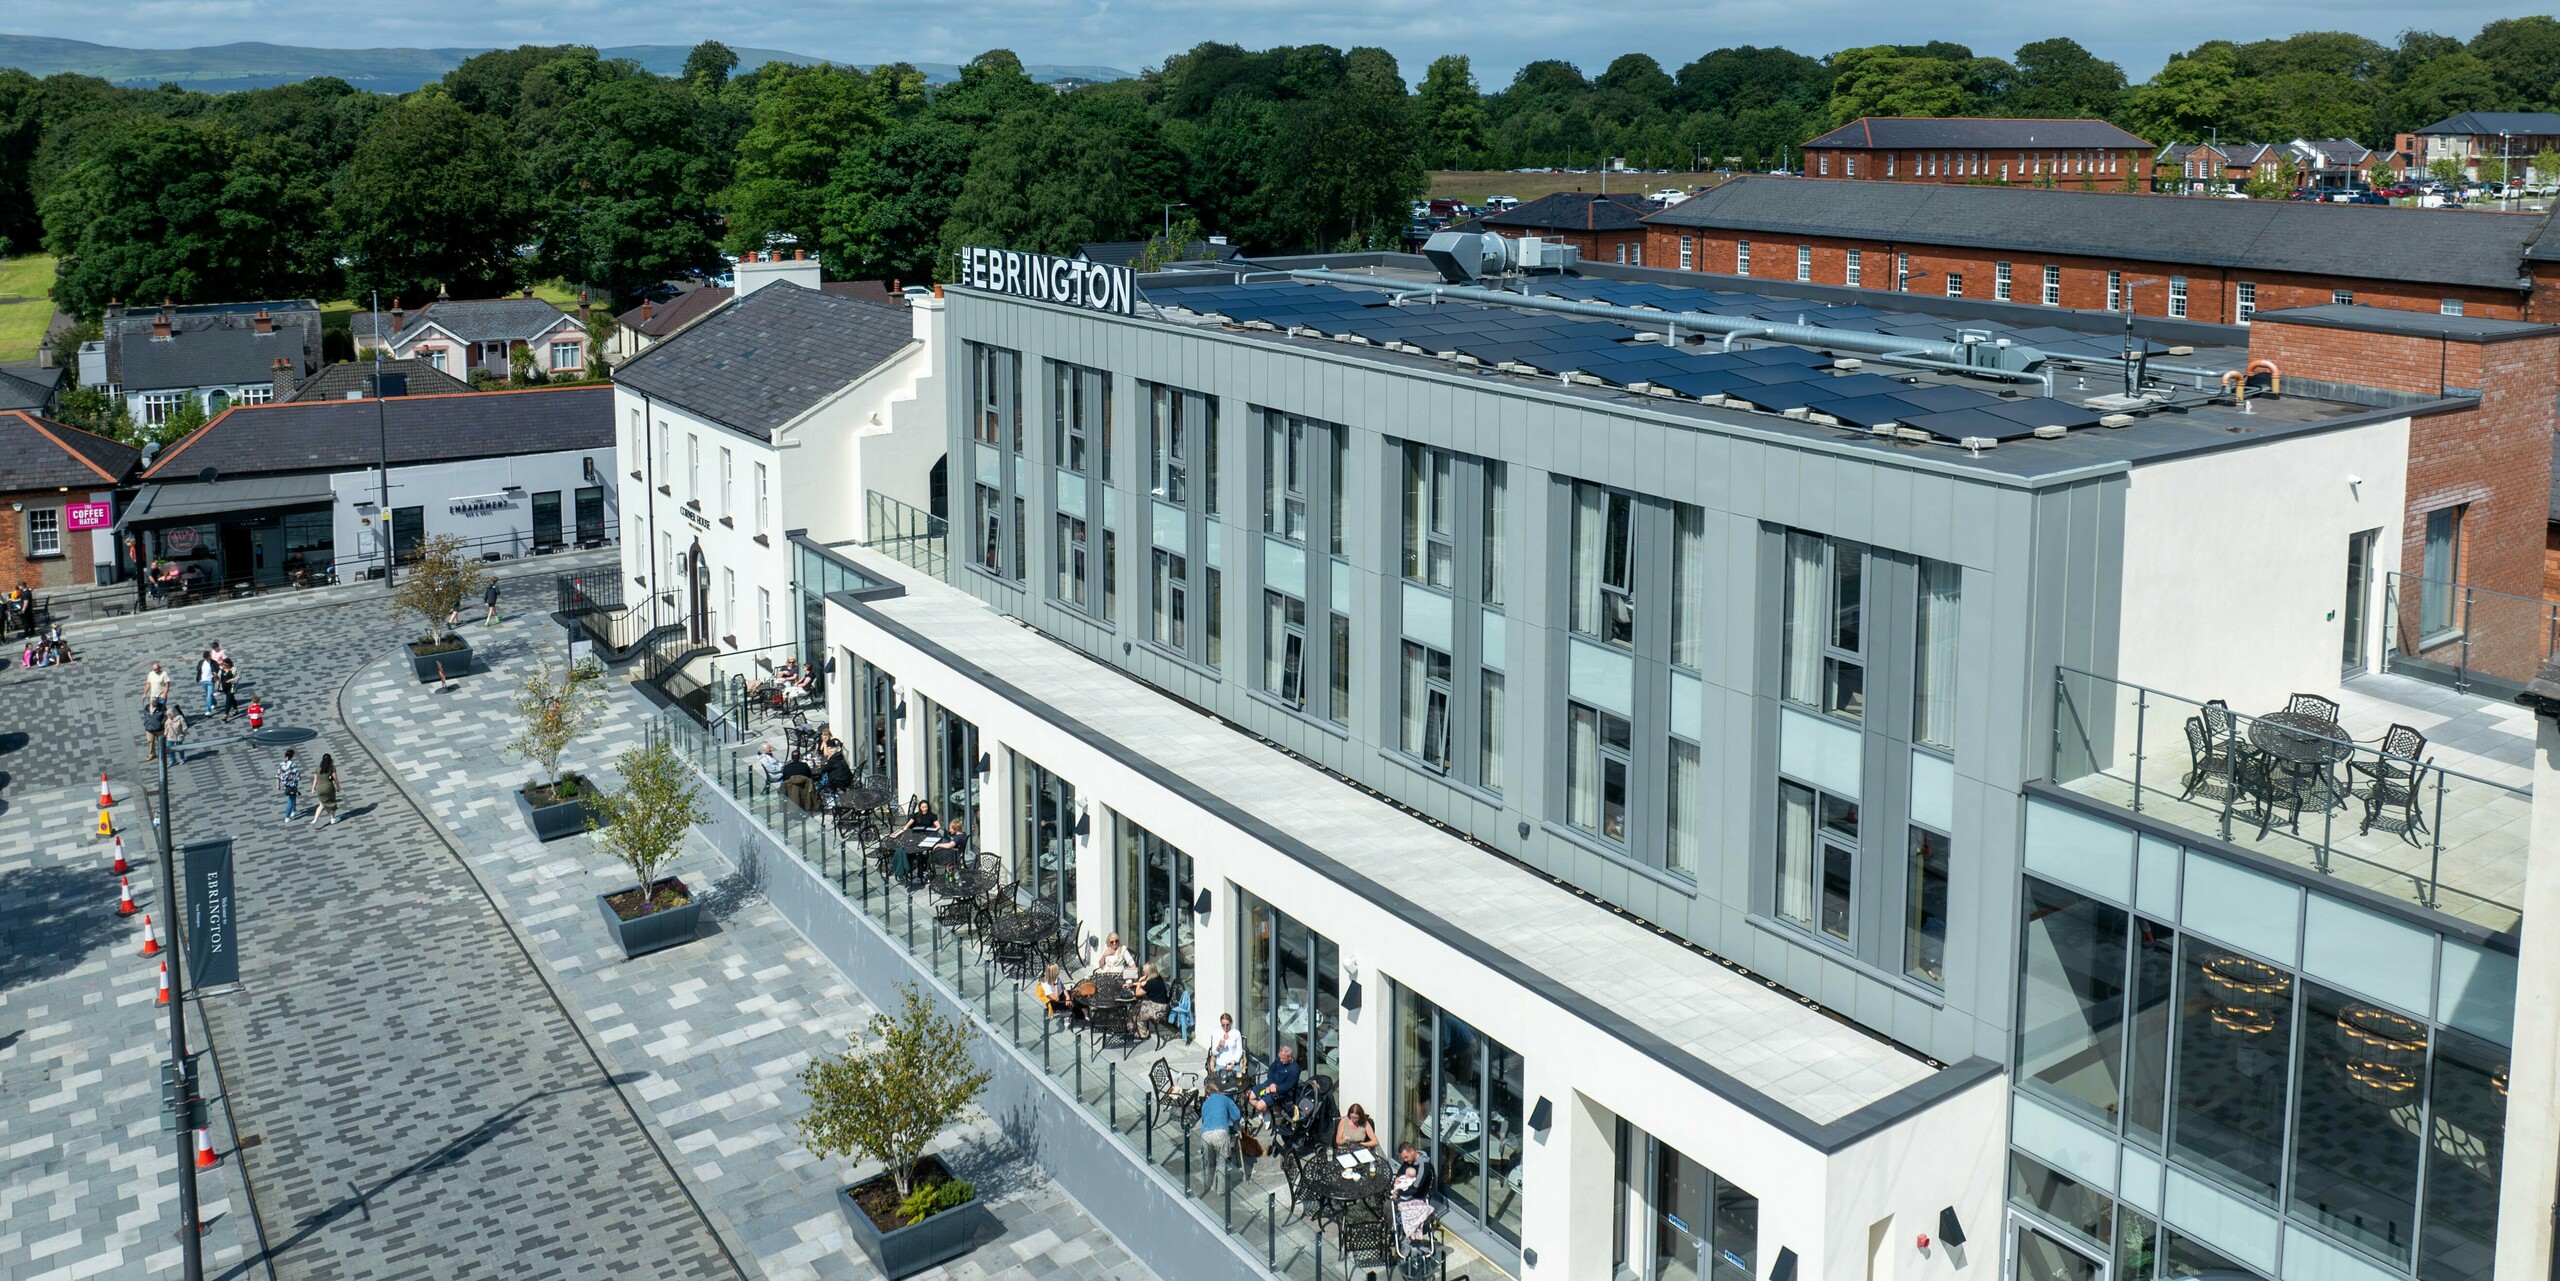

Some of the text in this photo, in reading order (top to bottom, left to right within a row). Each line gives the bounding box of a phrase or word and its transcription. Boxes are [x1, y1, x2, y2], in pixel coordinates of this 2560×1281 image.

[962, 246, 1131, 315] THE EBRINGTON
[73, 509, 104, 519] COFFEE
[449, 500, 507, 514] EMBANKMENT
[79, 517, 99, 525] HATCH
[208, 872, 222, 953] EBRINGTON
